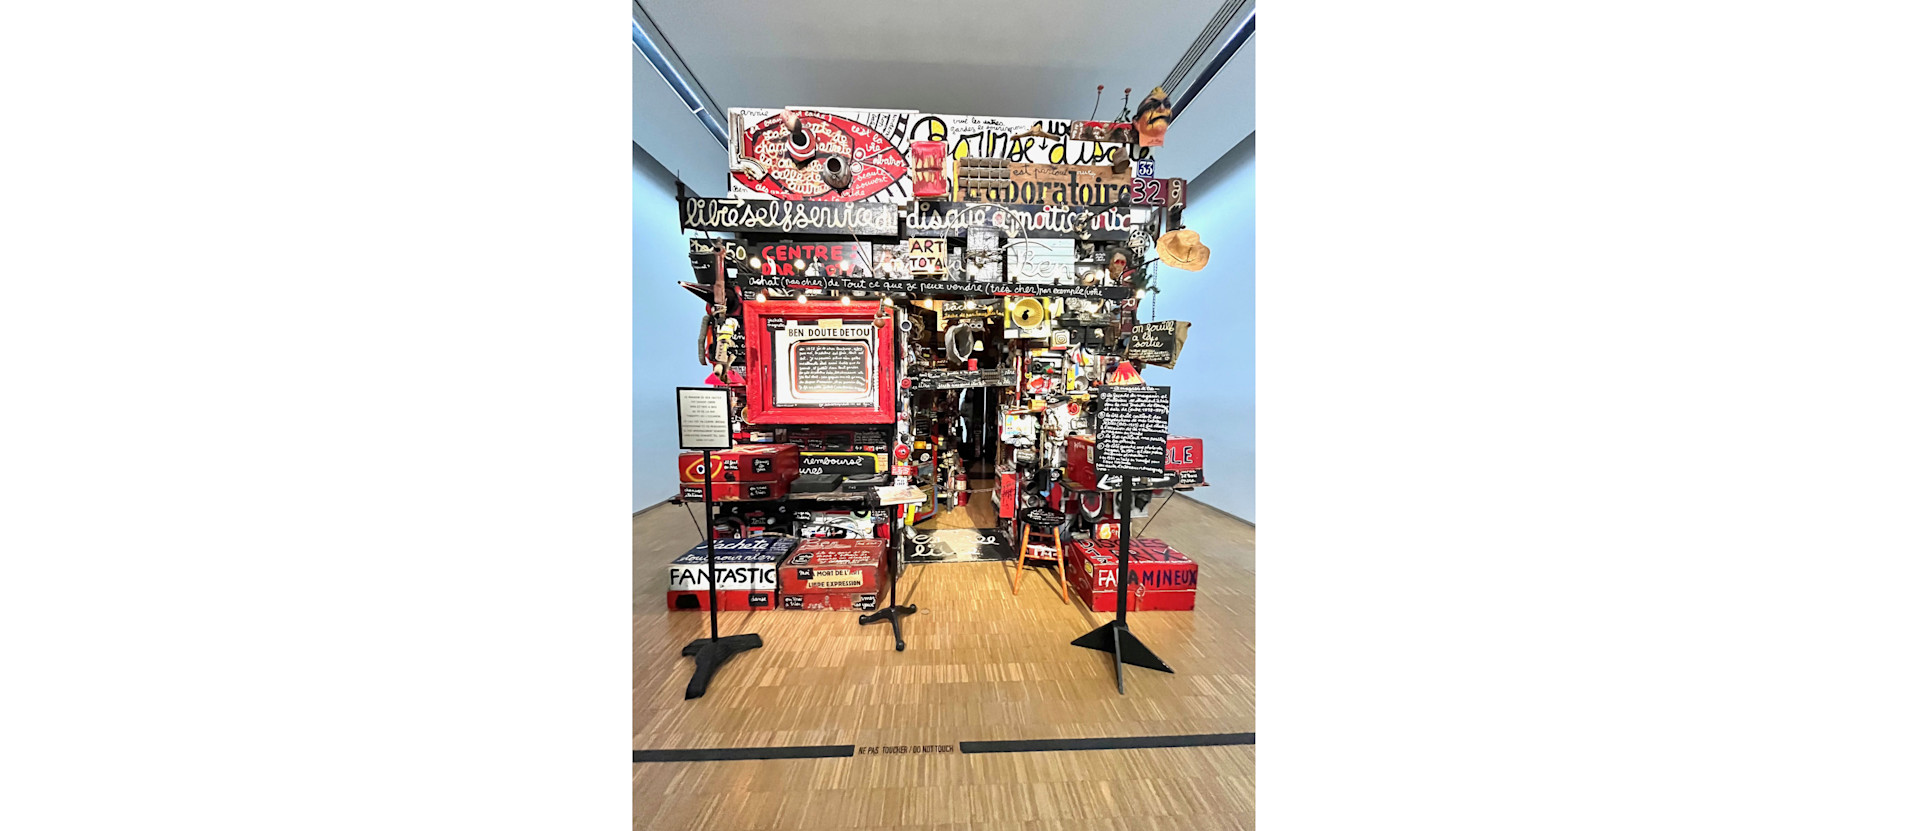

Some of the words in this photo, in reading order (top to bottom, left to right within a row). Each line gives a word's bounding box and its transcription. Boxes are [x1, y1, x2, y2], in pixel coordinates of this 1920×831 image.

[1138, 161, 1153, 176] 33
[1132, 178, 1165, 204] 32
[725, 242, 746, 260] 50
[761, 245, 844, 261] CENTRE
[910, 240, 943, 254] ART
[909, 258, 946, 270] TOTA
[883, 281, 903, 290] que
[947, 283, 983, 292] vendre
[788, 328, 804, 337] BEN
[808, 328, 838, 337] DOUTE
[671, 568, 775, 586] FANTASTIC
[1098, 568, 1197, 588] FAAMINEUX
[859, 747, 867, 755] NE
[867, 747, 880, 755] PAS
[882, 746, 908, 754] TOUCHER
[935, 745, 954, 753] TOUCH
